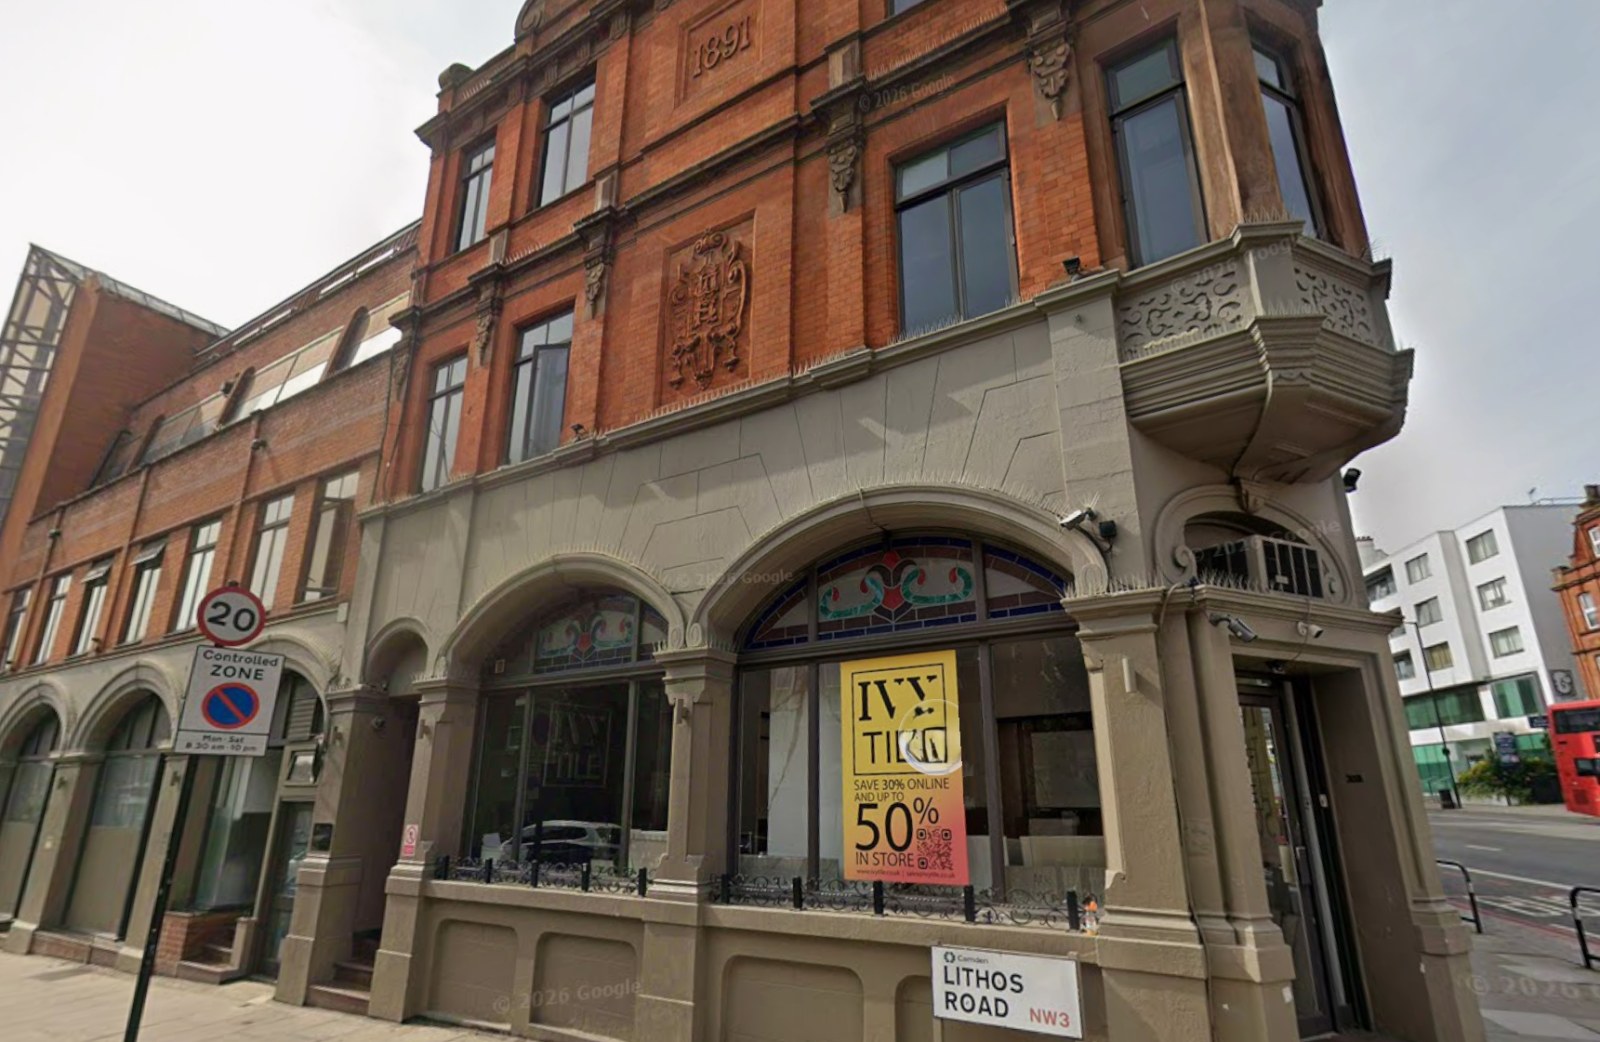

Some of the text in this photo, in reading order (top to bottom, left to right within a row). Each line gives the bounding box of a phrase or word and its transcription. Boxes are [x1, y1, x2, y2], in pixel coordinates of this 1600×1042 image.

[692, 16, 752, 79] 1891
[207, 601, 256, 632] 20
[203, 650, 279, 667] Controlled
[210, 664, 265, 680] ZONE
[858, 674, 938, 721] IVY
[854, 778, 950, 791] SAVE 30% ONLINE
[854, 791, 904, 802] AND UP TO
[855, 796, 939, 852] 50%
[856, 852, 915, 867] IN STORE
[957, 952, 989, 964] Camden
[943, 965, 1024, 994] LITHOS
[944, 991, 1010, 1018] ROAD
[1029, 1007, 1070, 1028] NW3
